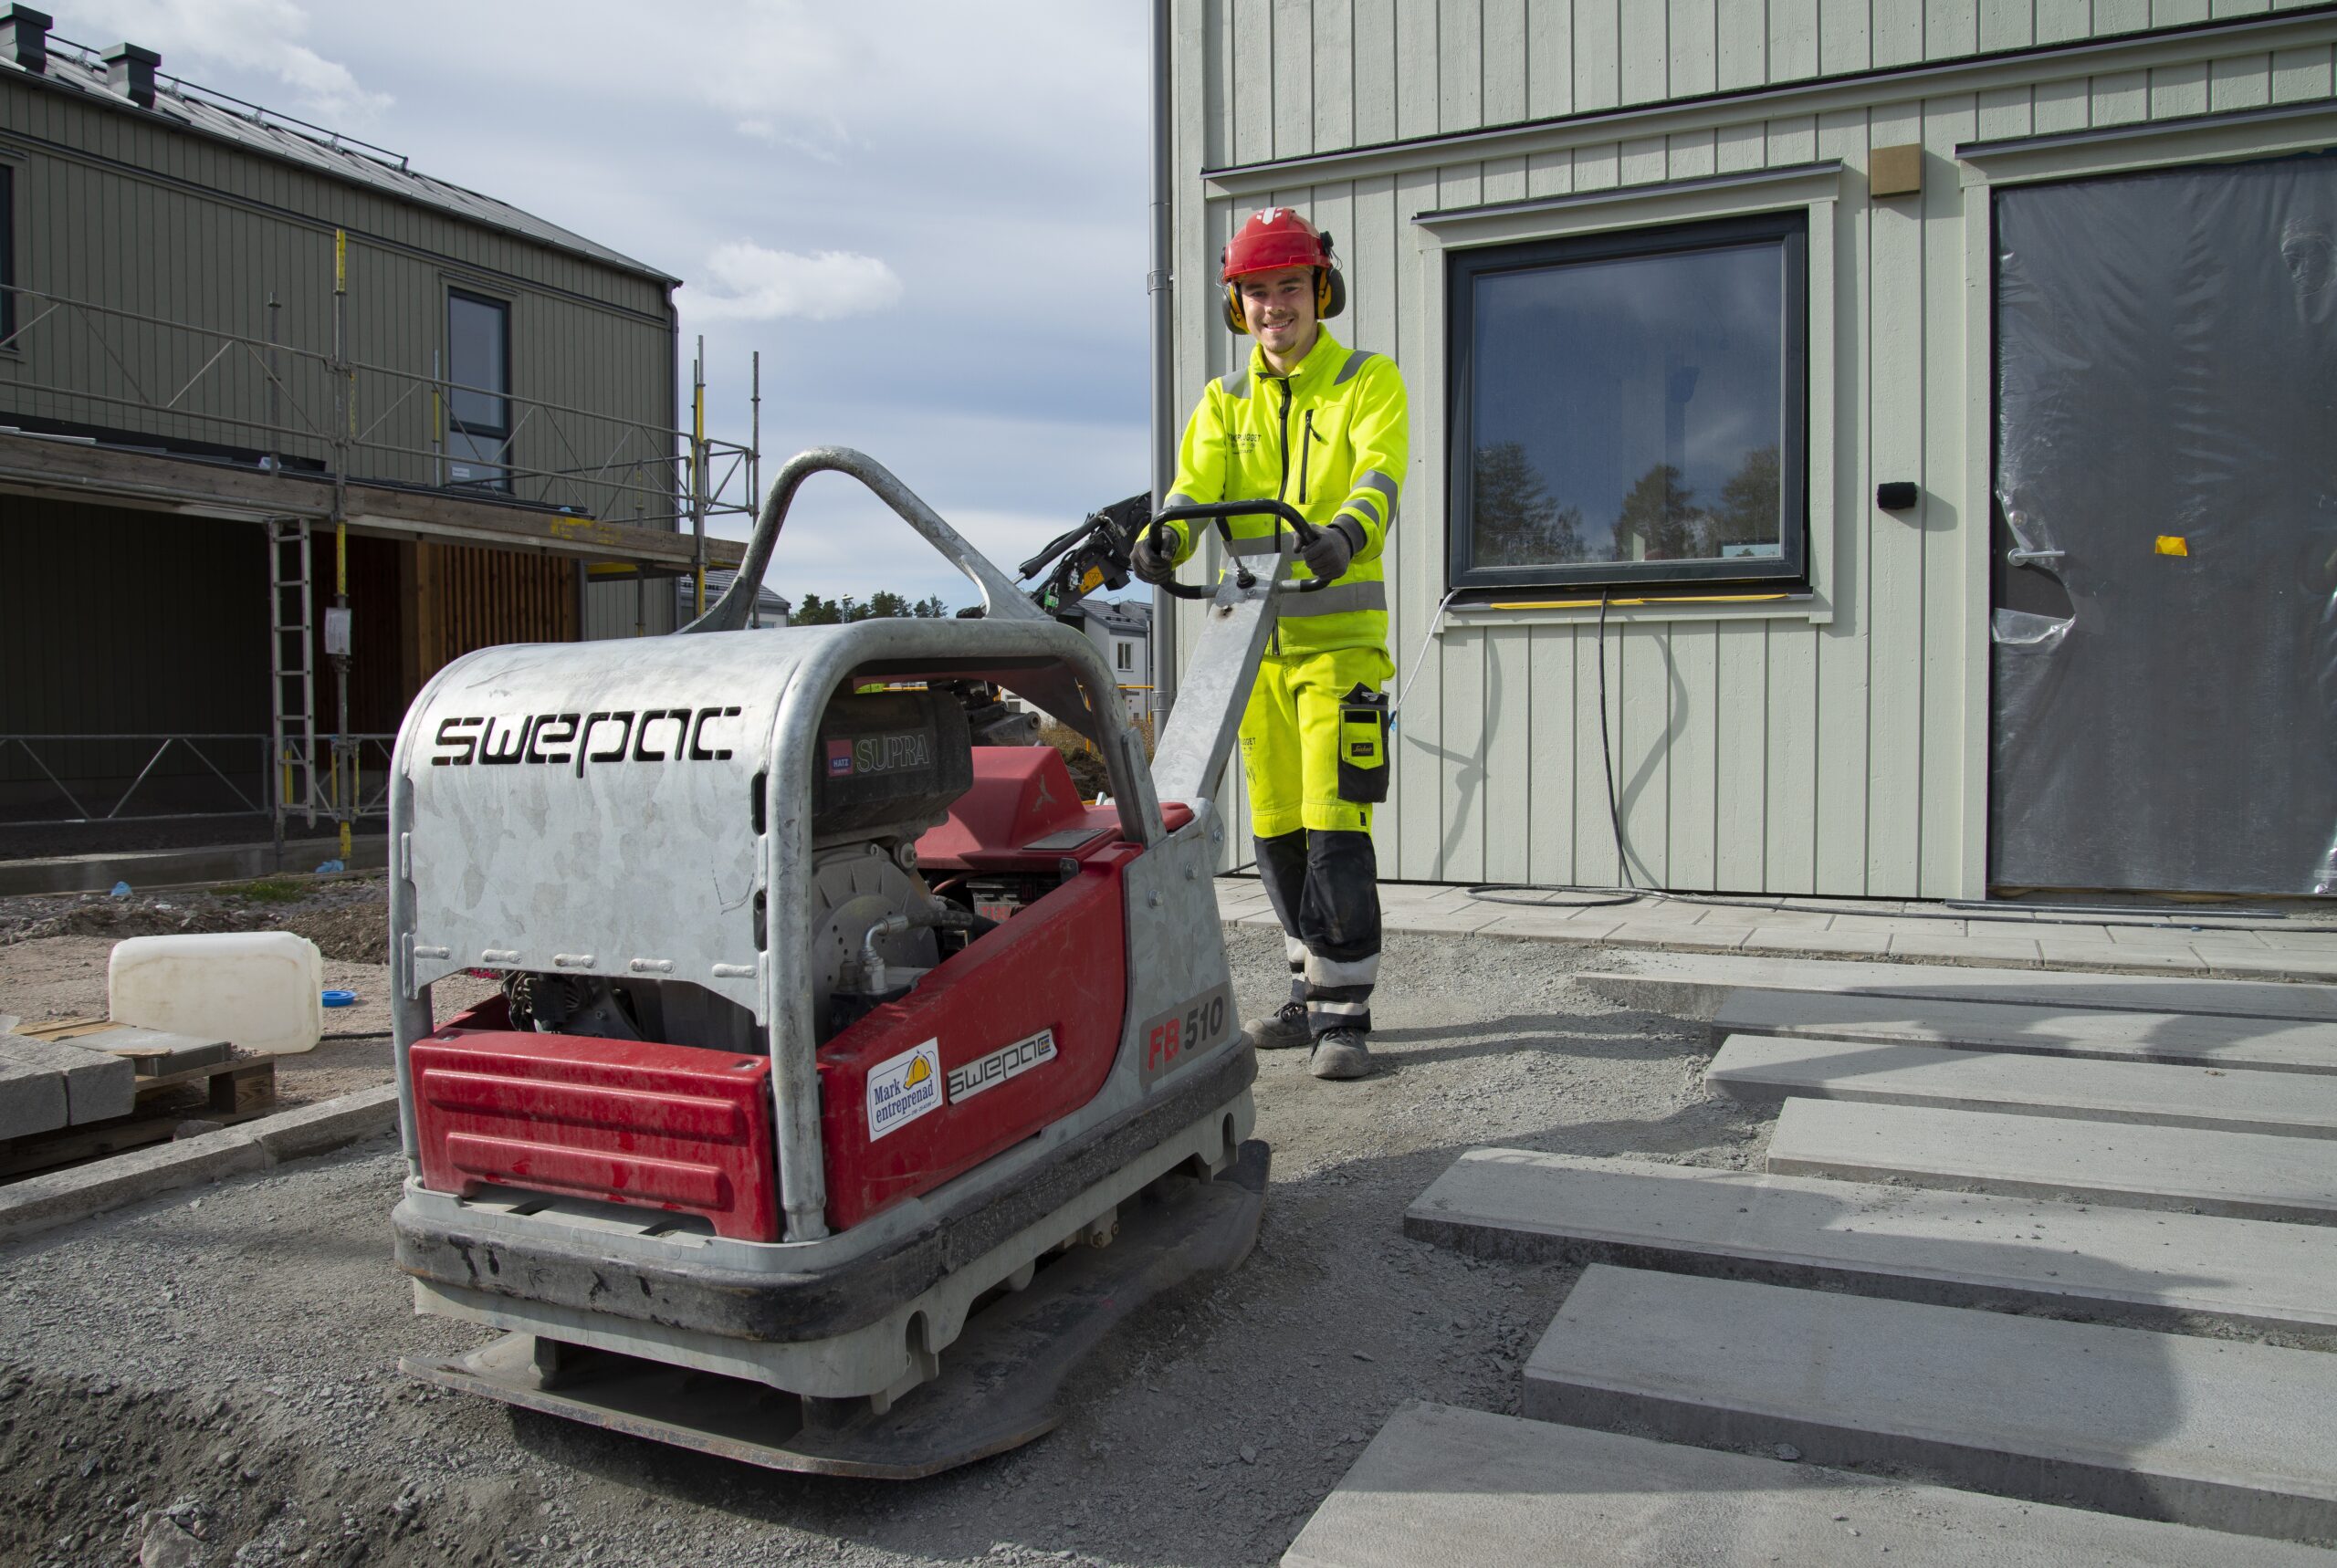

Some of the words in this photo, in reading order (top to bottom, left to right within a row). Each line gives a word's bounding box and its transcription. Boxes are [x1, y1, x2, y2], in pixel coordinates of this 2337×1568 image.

[833, 758, 849, 768] HATZ
[856, 734, 929, 773] SUPRA
[1148, 1018, 1180, 1071] FB
[1184, 996, 1223, 1050] 510
[874, 1079, 901, 1105] Mark
[876, 1080, 934, 1124] entreprenad
